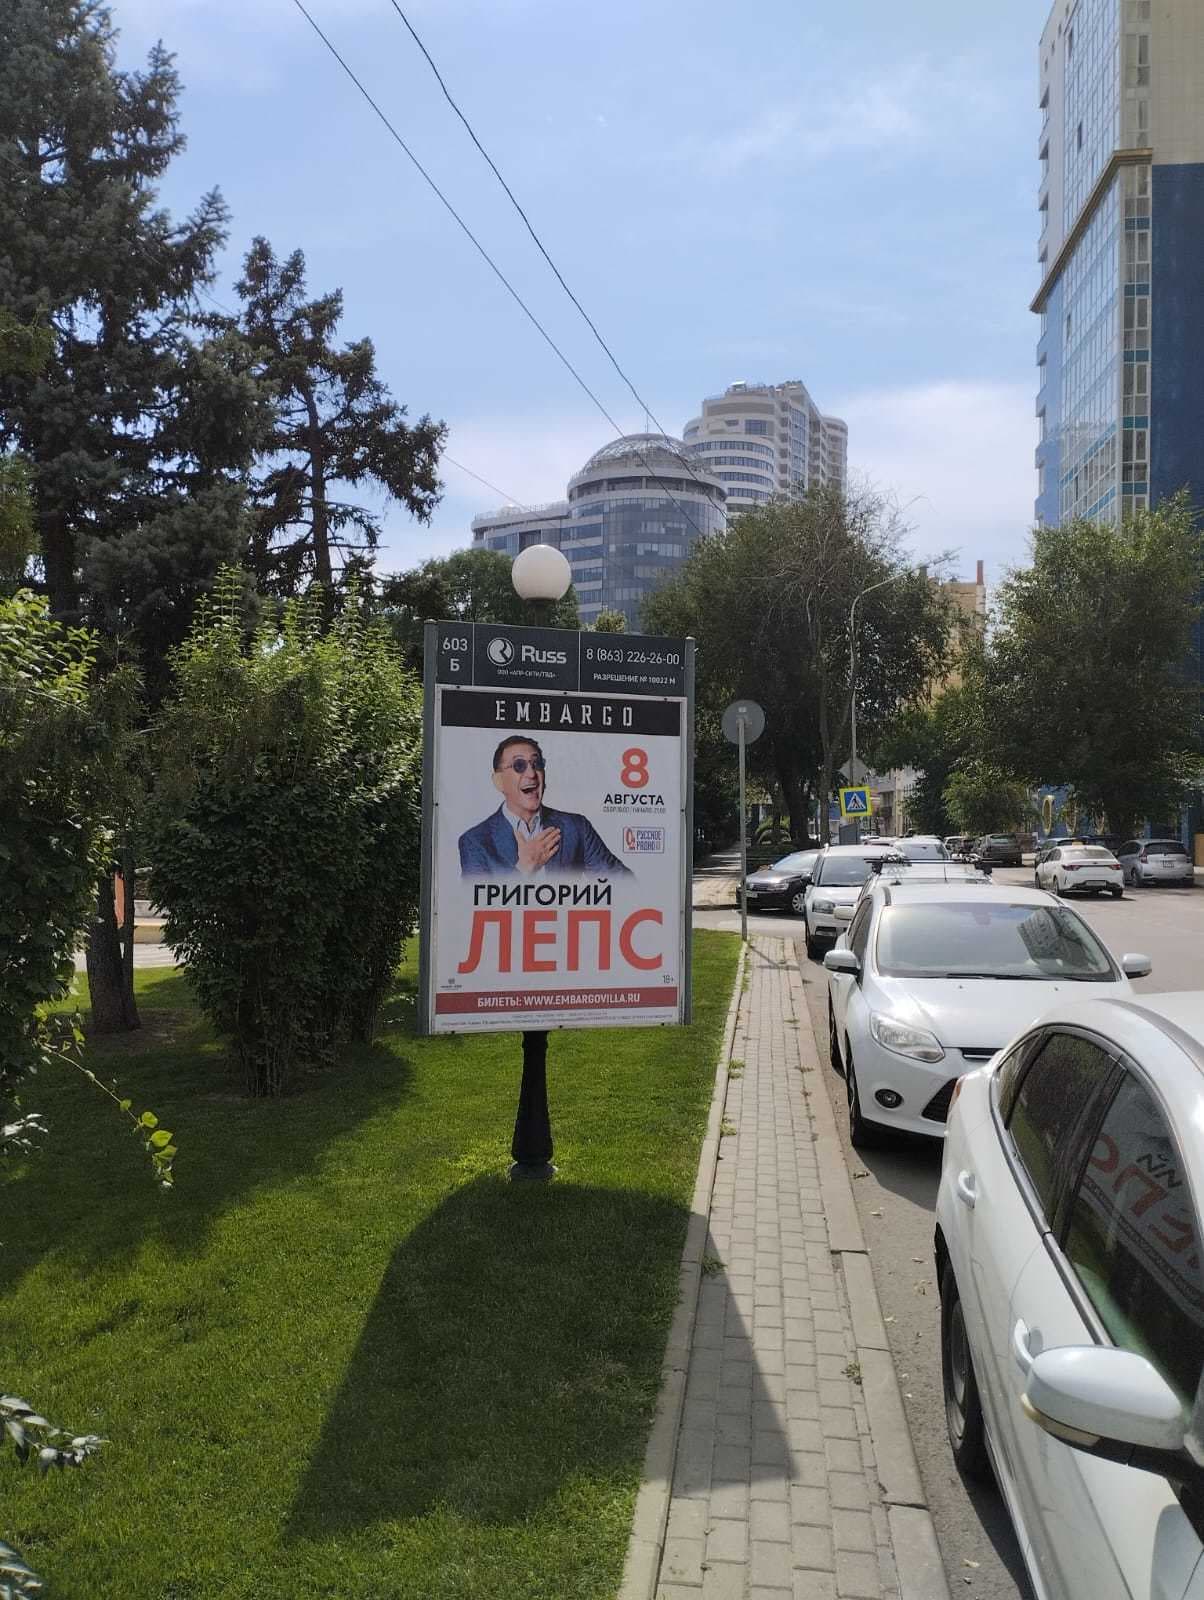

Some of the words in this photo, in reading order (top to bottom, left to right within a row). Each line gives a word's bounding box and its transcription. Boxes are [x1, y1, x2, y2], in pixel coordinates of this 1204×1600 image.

[443, 637, 468, 651] 603
[521, 645, 567, 664] Russ
[586, 648, 594, 660] 8
[597, 647, 623, 663] (863)
[627, 651, 680, 665] 226-26-00
[450, 658, 460, 671] Б
[593, 673, 638, 683] РАЗРЕШЕНИЕ
[495, 700, 633, 727] EMBARGO
[620, 747, 649, 788] 8
[603, 793, 665, 806] АВГУСТА
[473, 878, 612, 906] ГРИГОРИЙ
[457, 909, 663, 973] ЛЕПС
[477, 996, 521, 1008] БИЛЕТЫ:
[523, 992, 641, 1006] WWW.EMBARGOVILLA.RU
